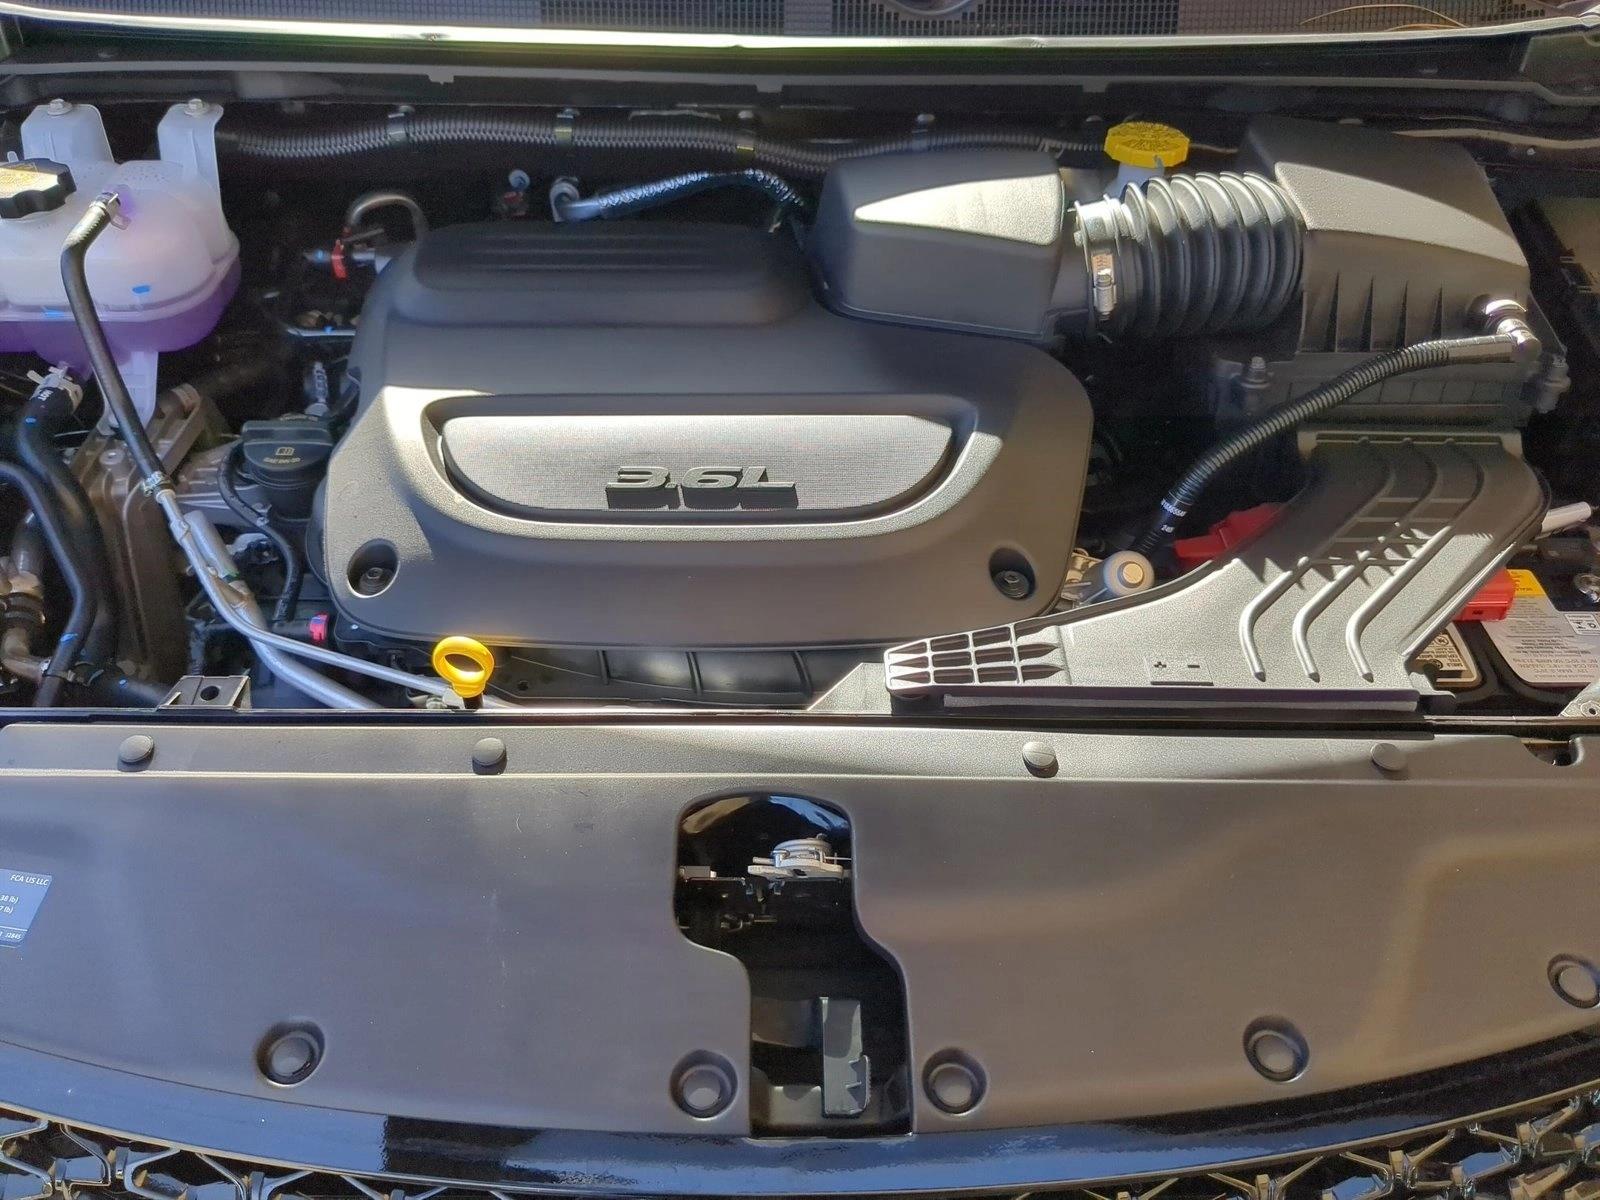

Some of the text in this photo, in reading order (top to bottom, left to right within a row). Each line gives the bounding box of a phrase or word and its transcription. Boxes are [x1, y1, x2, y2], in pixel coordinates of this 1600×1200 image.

[606, 466, 795, 488] 3.6L
[10, 874, 49, 886] FCA US LLC
